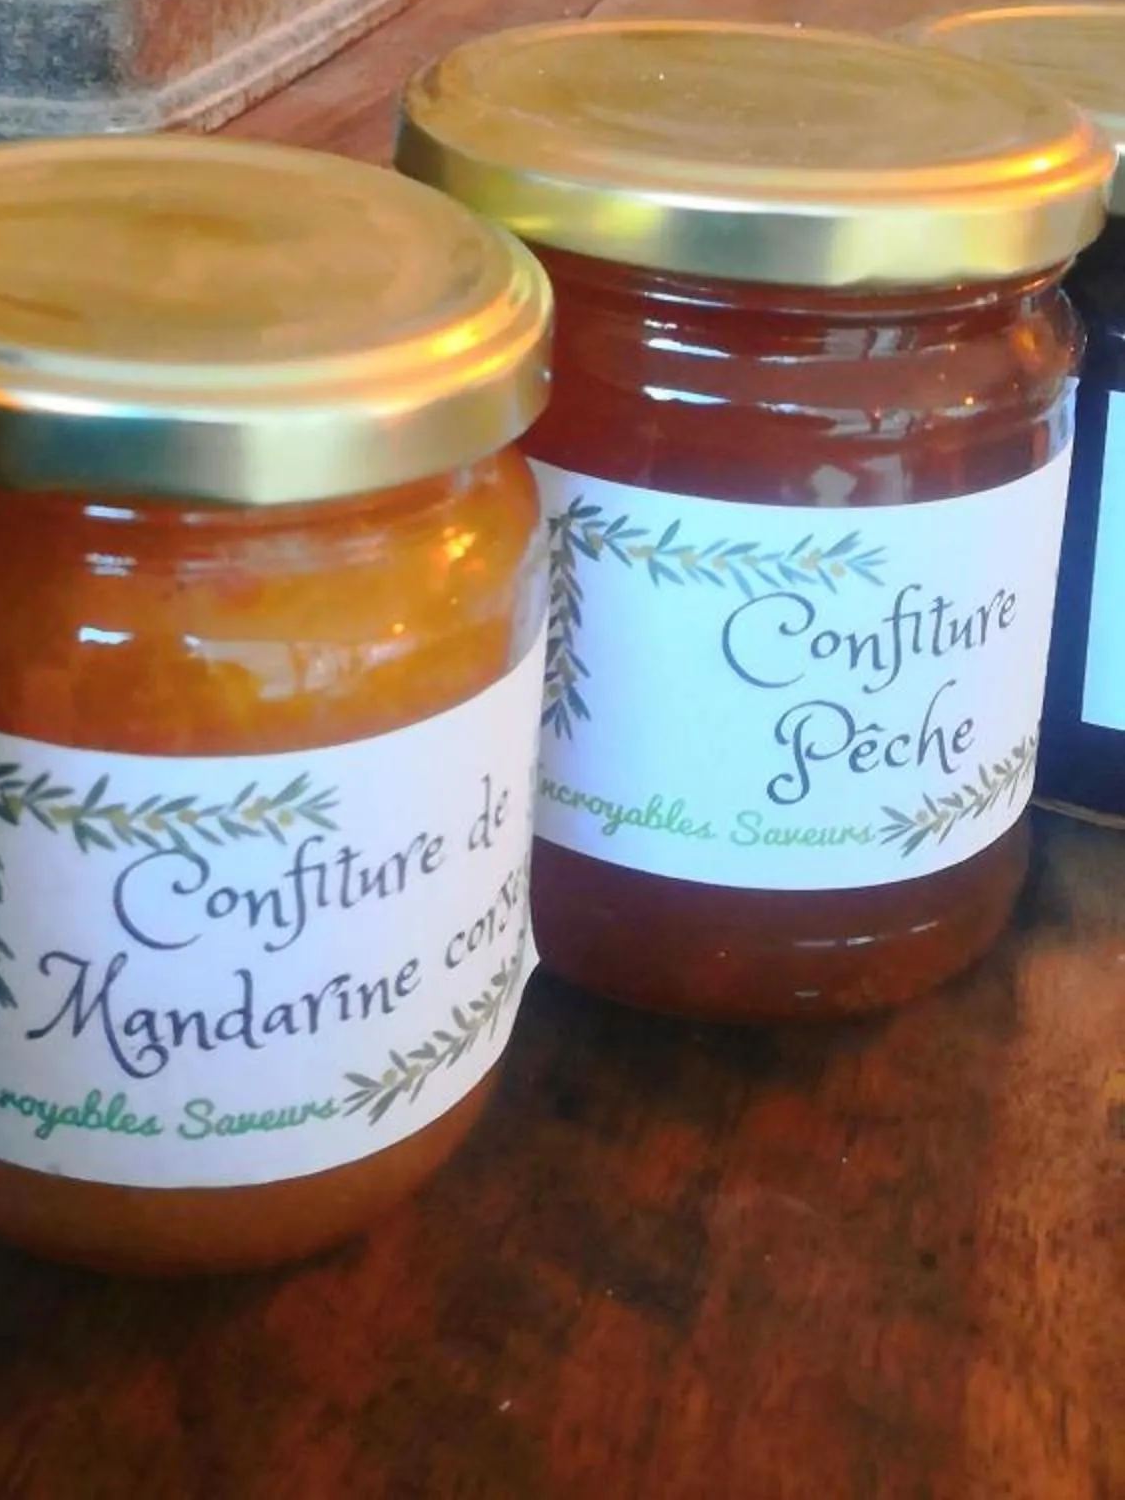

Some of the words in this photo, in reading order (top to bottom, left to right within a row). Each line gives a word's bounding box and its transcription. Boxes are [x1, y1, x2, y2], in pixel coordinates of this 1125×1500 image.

[721, 583, 1018, 695] Confiture
[766, 679, 975, 805] Pêche
[113, 831, 447, 953] Confiture
[468, 772, 509, 852] de
[538, 763, 718, 840] ncroyables
[729, 810, 875, 847] Saveurs
[26, 949, 421, 1080] Mandarine
[178, 1097, 342, 1141] Saveurs
